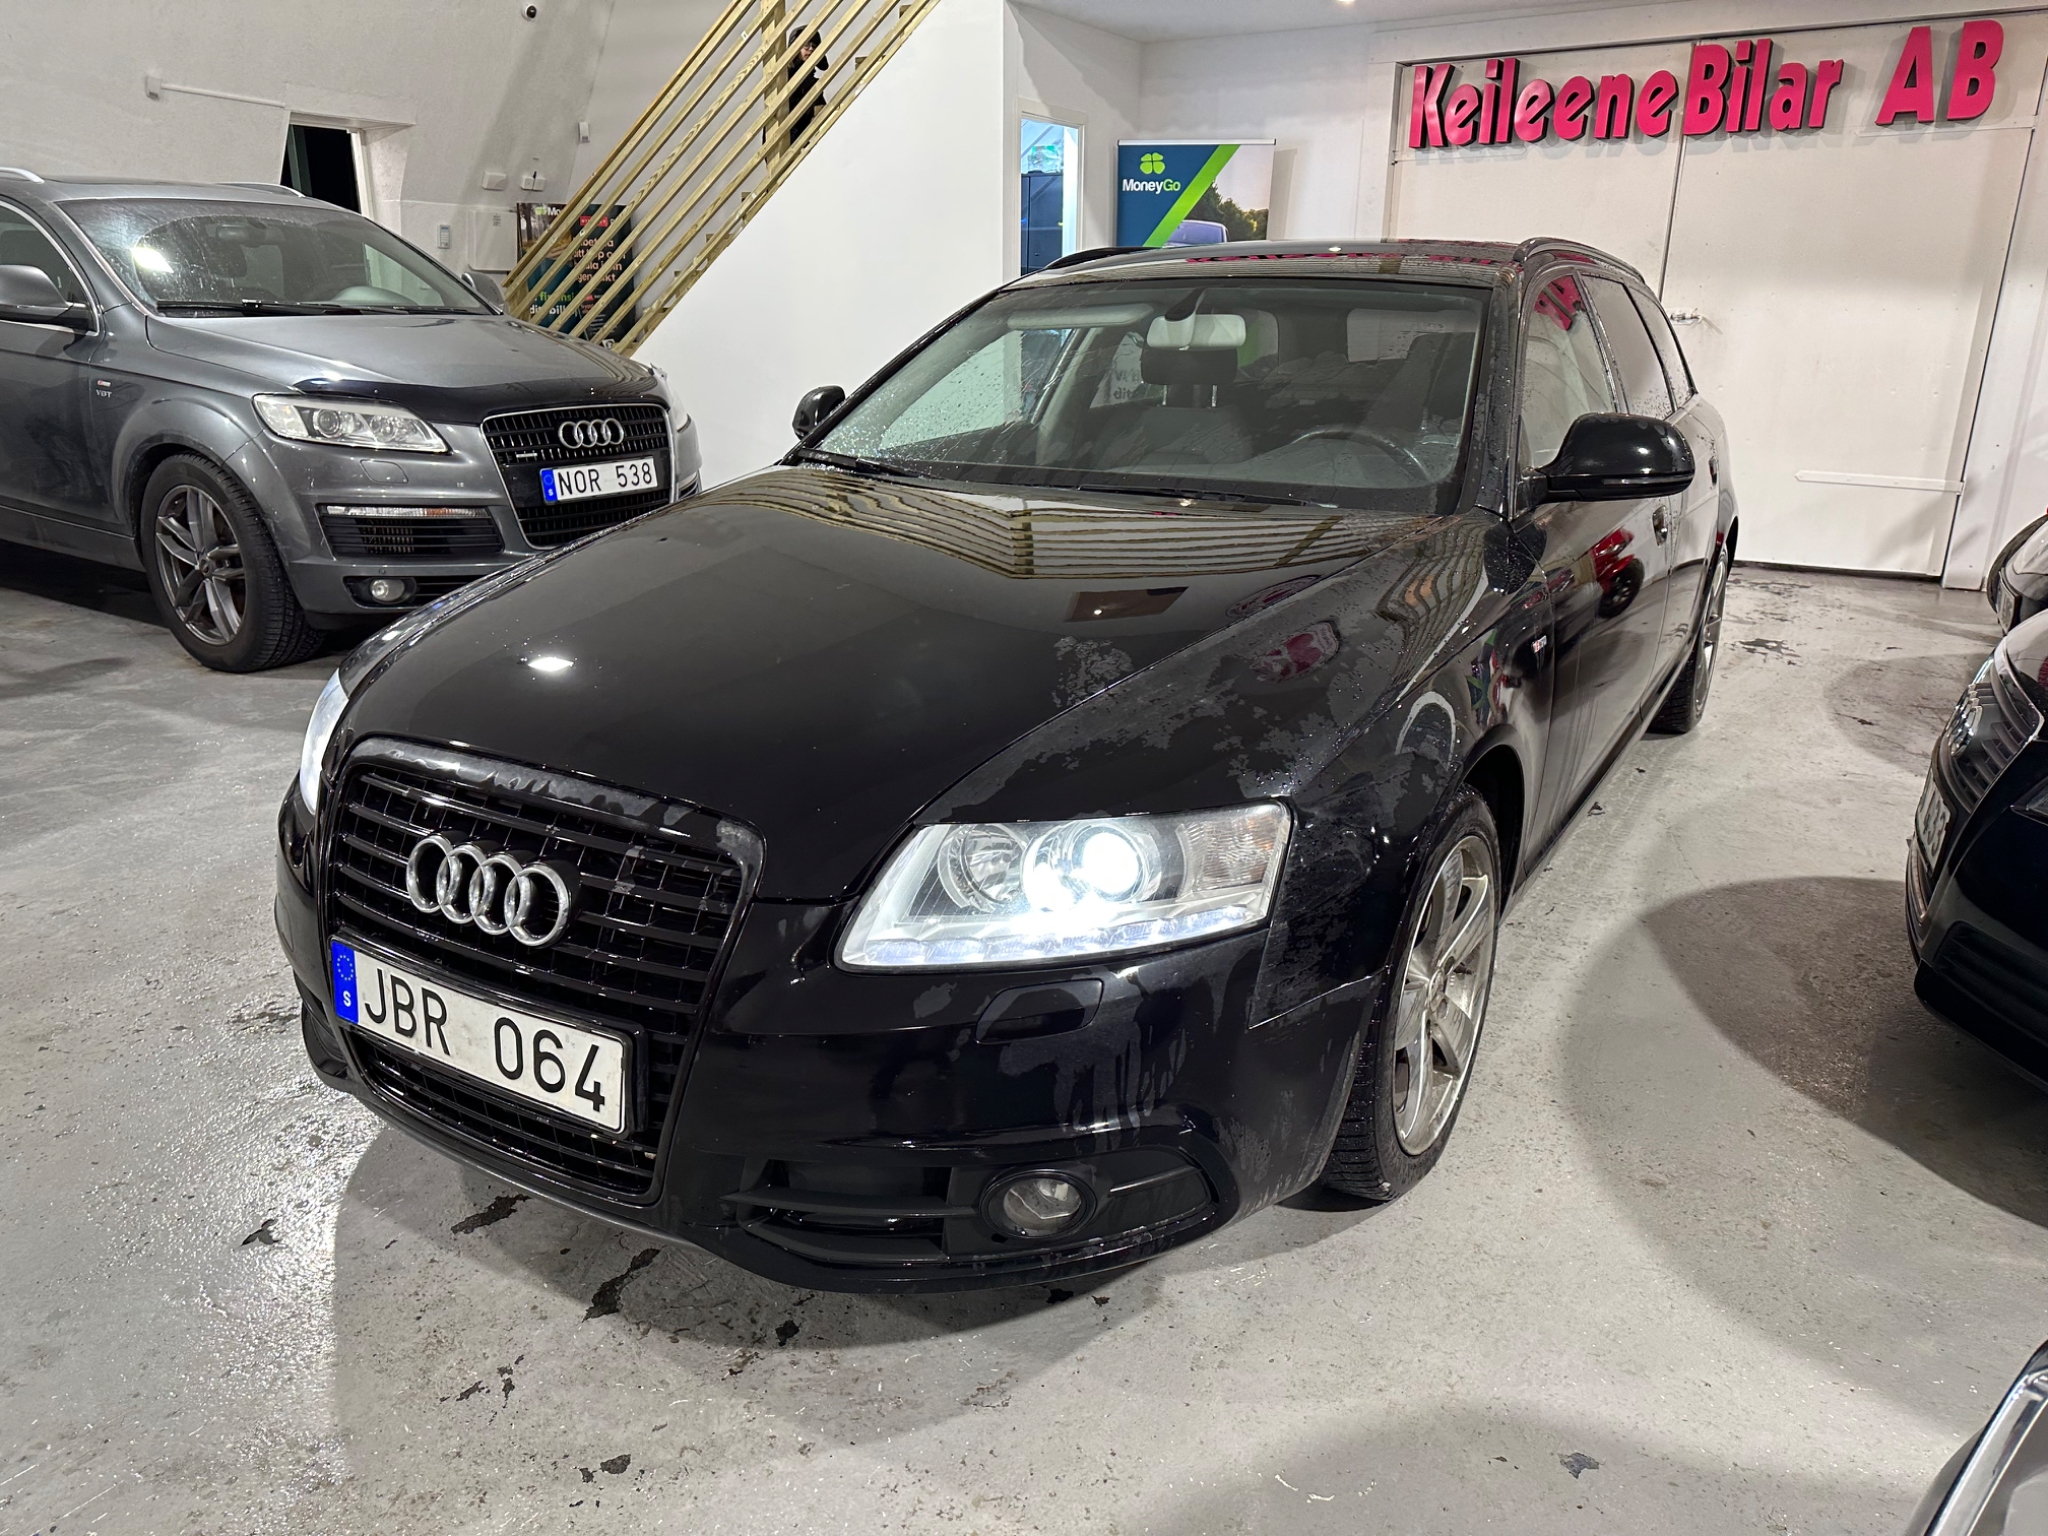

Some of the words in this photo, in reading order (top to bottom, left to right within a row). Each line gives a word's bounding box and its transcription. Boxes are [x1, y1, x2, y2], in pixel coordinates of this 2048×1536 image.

[1875, 19, 2005, 125] AB
[1122, 178, 1181, 194] MoneyGo
[557, 469, 602, 496] NOR
[615, 462, 652, 488] 538
[342, 990, 352, 1007] S
[364, 967, 451, 1057] JBR
[493, 1016, 606, 1113] 064
